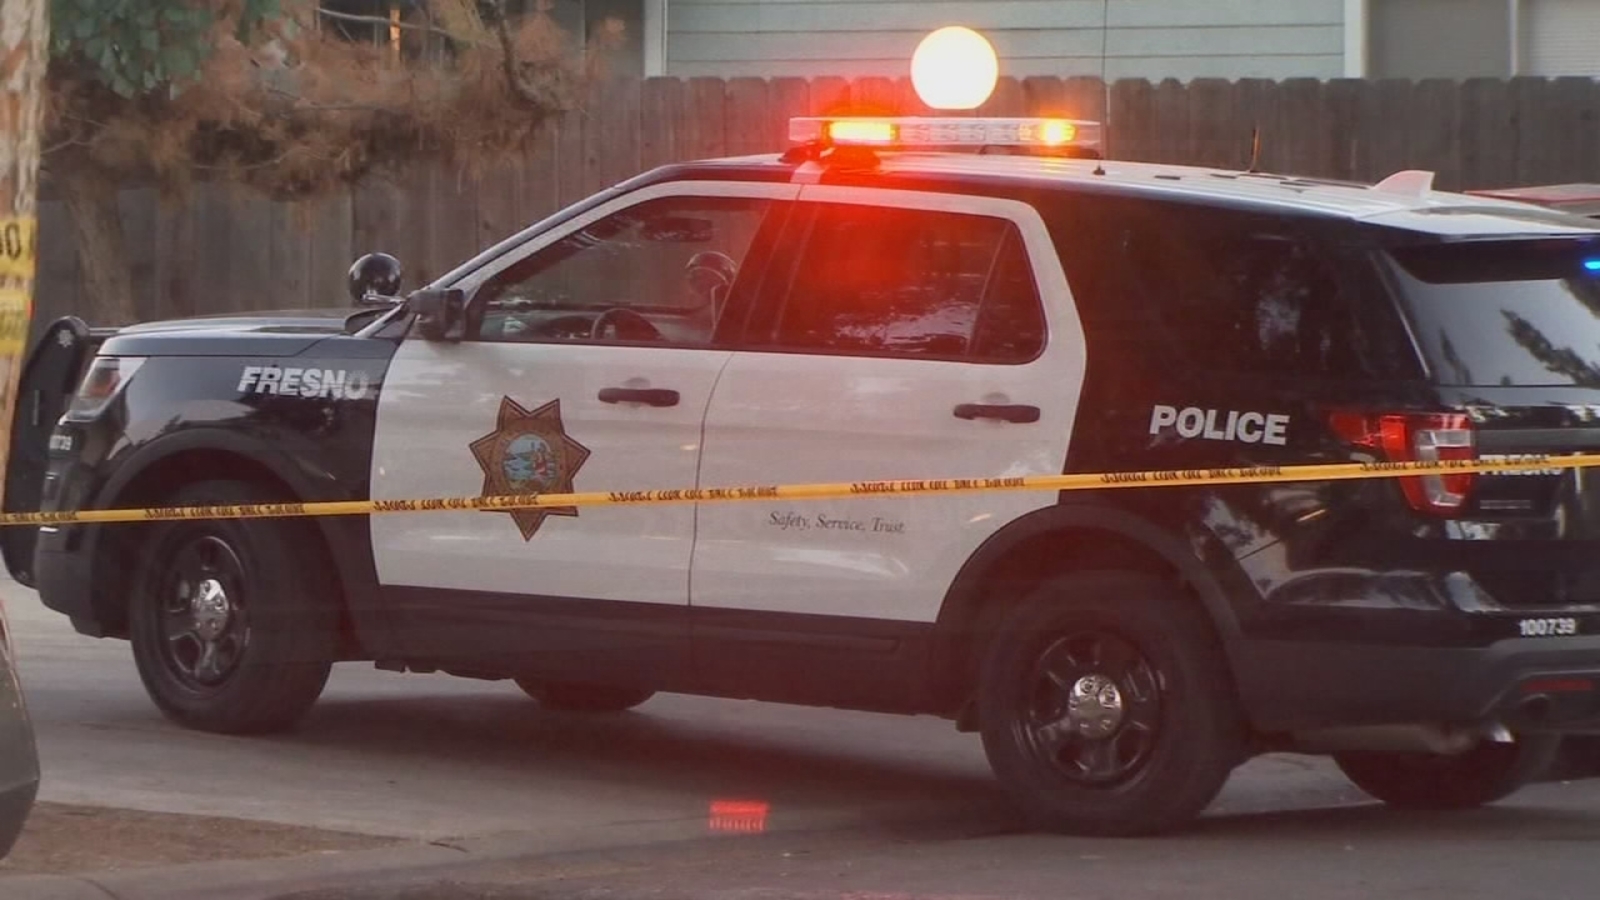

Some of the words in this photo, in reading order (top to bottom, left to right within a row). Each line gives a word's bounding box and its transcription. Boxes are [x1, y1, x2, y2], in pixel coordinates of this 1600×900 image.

[237, 366, 369, 400] FRESNO
[1150, 404, 1290, 445] POLICE
[1520, 618, 1576, 635] 100739
